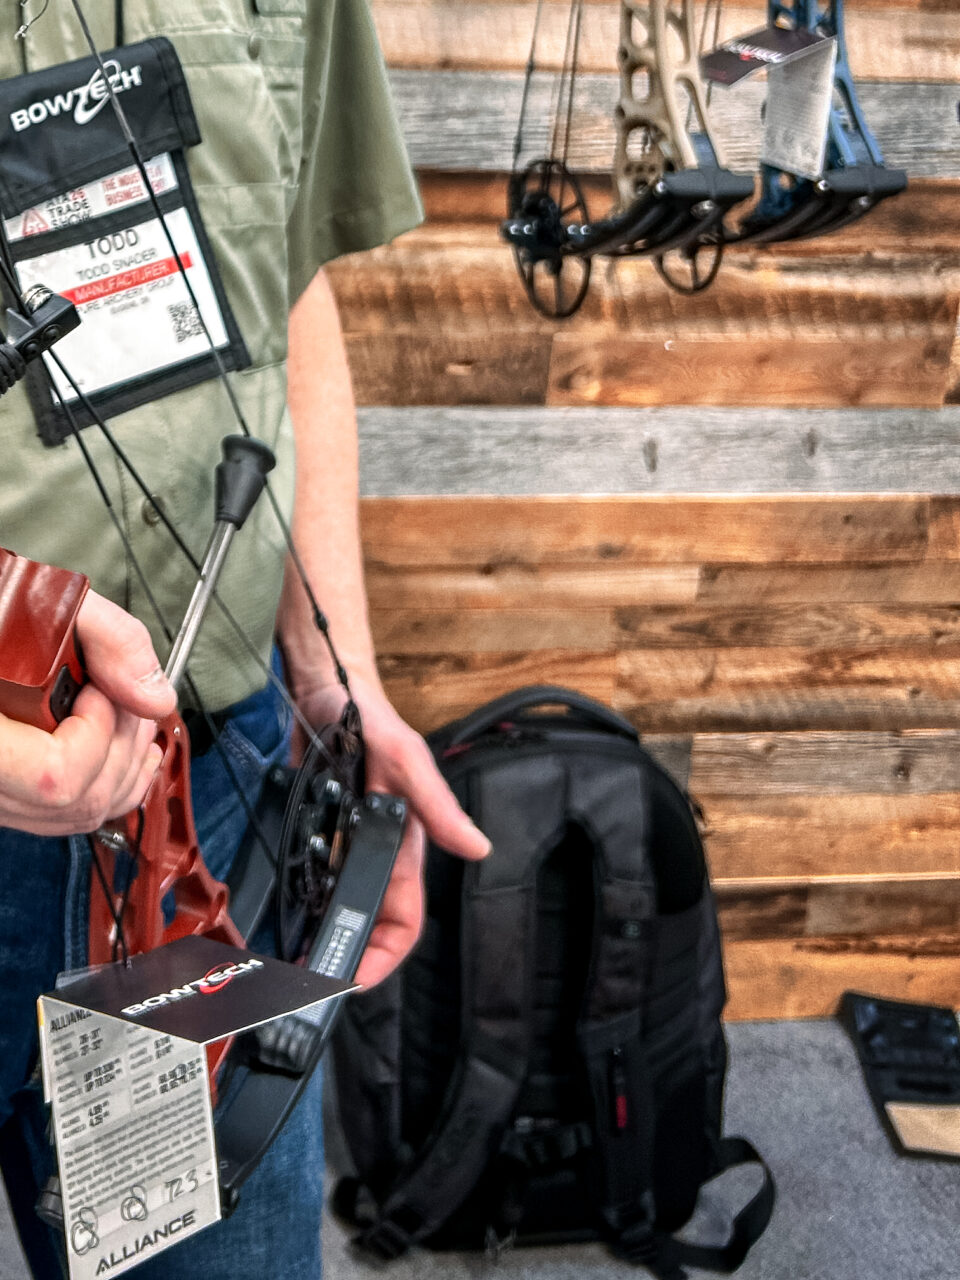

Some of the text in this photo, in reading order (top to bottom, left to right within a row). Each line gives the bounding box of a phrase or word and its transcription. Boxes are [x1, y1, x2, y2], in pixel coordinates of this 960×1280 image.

[9, 62, 142, 132] BOWTECH
[48, 198, 90, 219] TRADE
[84, 228, 139, 259] TODD
[74, 261, 169, 301] MANUFACTURER
[76, 263, 111, 281] TODD
[121, 958, 265, 1015] BOWTECH
[95, 1209, 197, 1277] ALLIANCE
